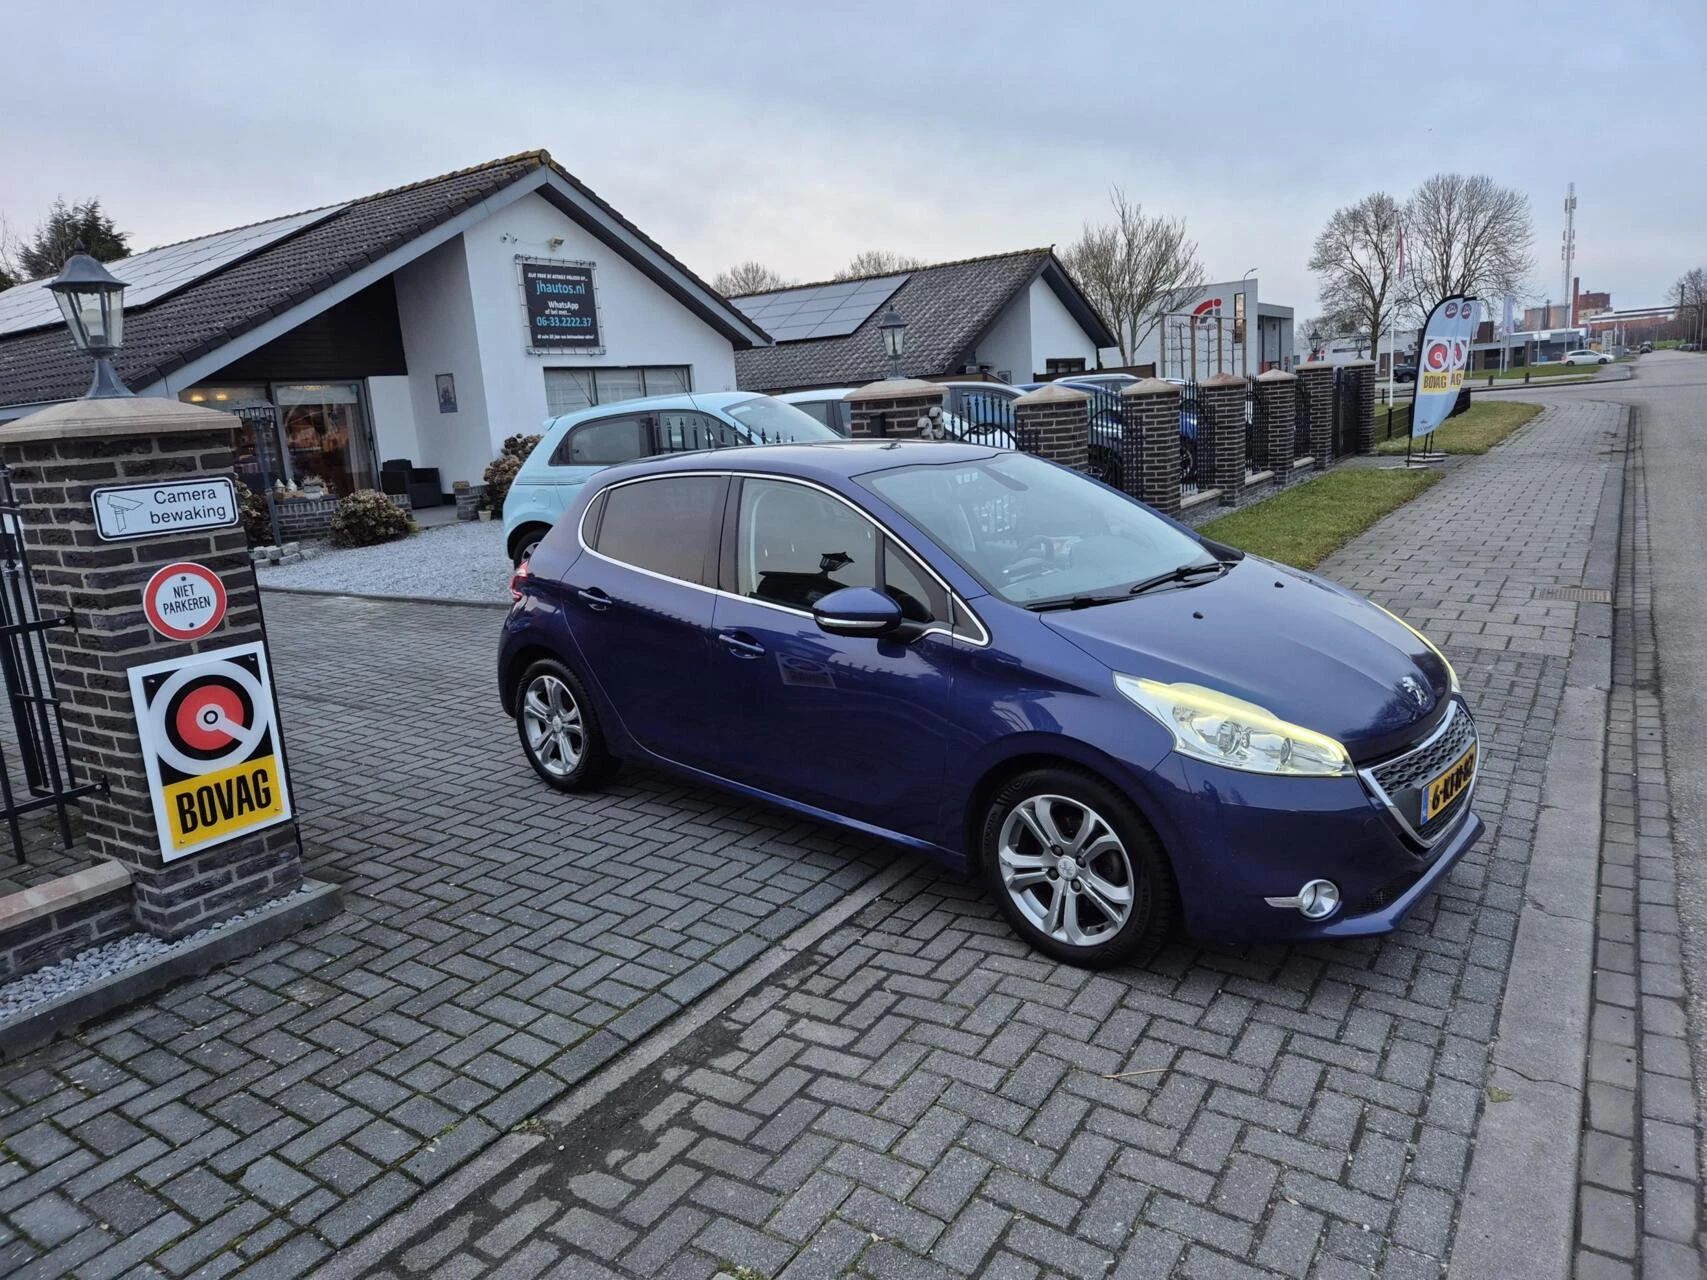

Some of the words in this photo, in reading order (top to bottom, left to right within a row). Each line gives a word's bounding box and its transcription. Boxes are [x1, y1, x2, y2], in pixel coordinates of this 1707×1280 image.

[536, 280, 585, 295] jhautos.nl
[547, 300, 579, 311] WhatsApp
[536, 316, 592, 327] 06-33.2222.37
[153, 486, 217, 505] Camera
[150, 504, 226, 525] bewaking
[173, 583, 195, 600] NIET
[163, 597, 211, 616] PARKEREN
[176, 768, 272, 835] BOVAG
